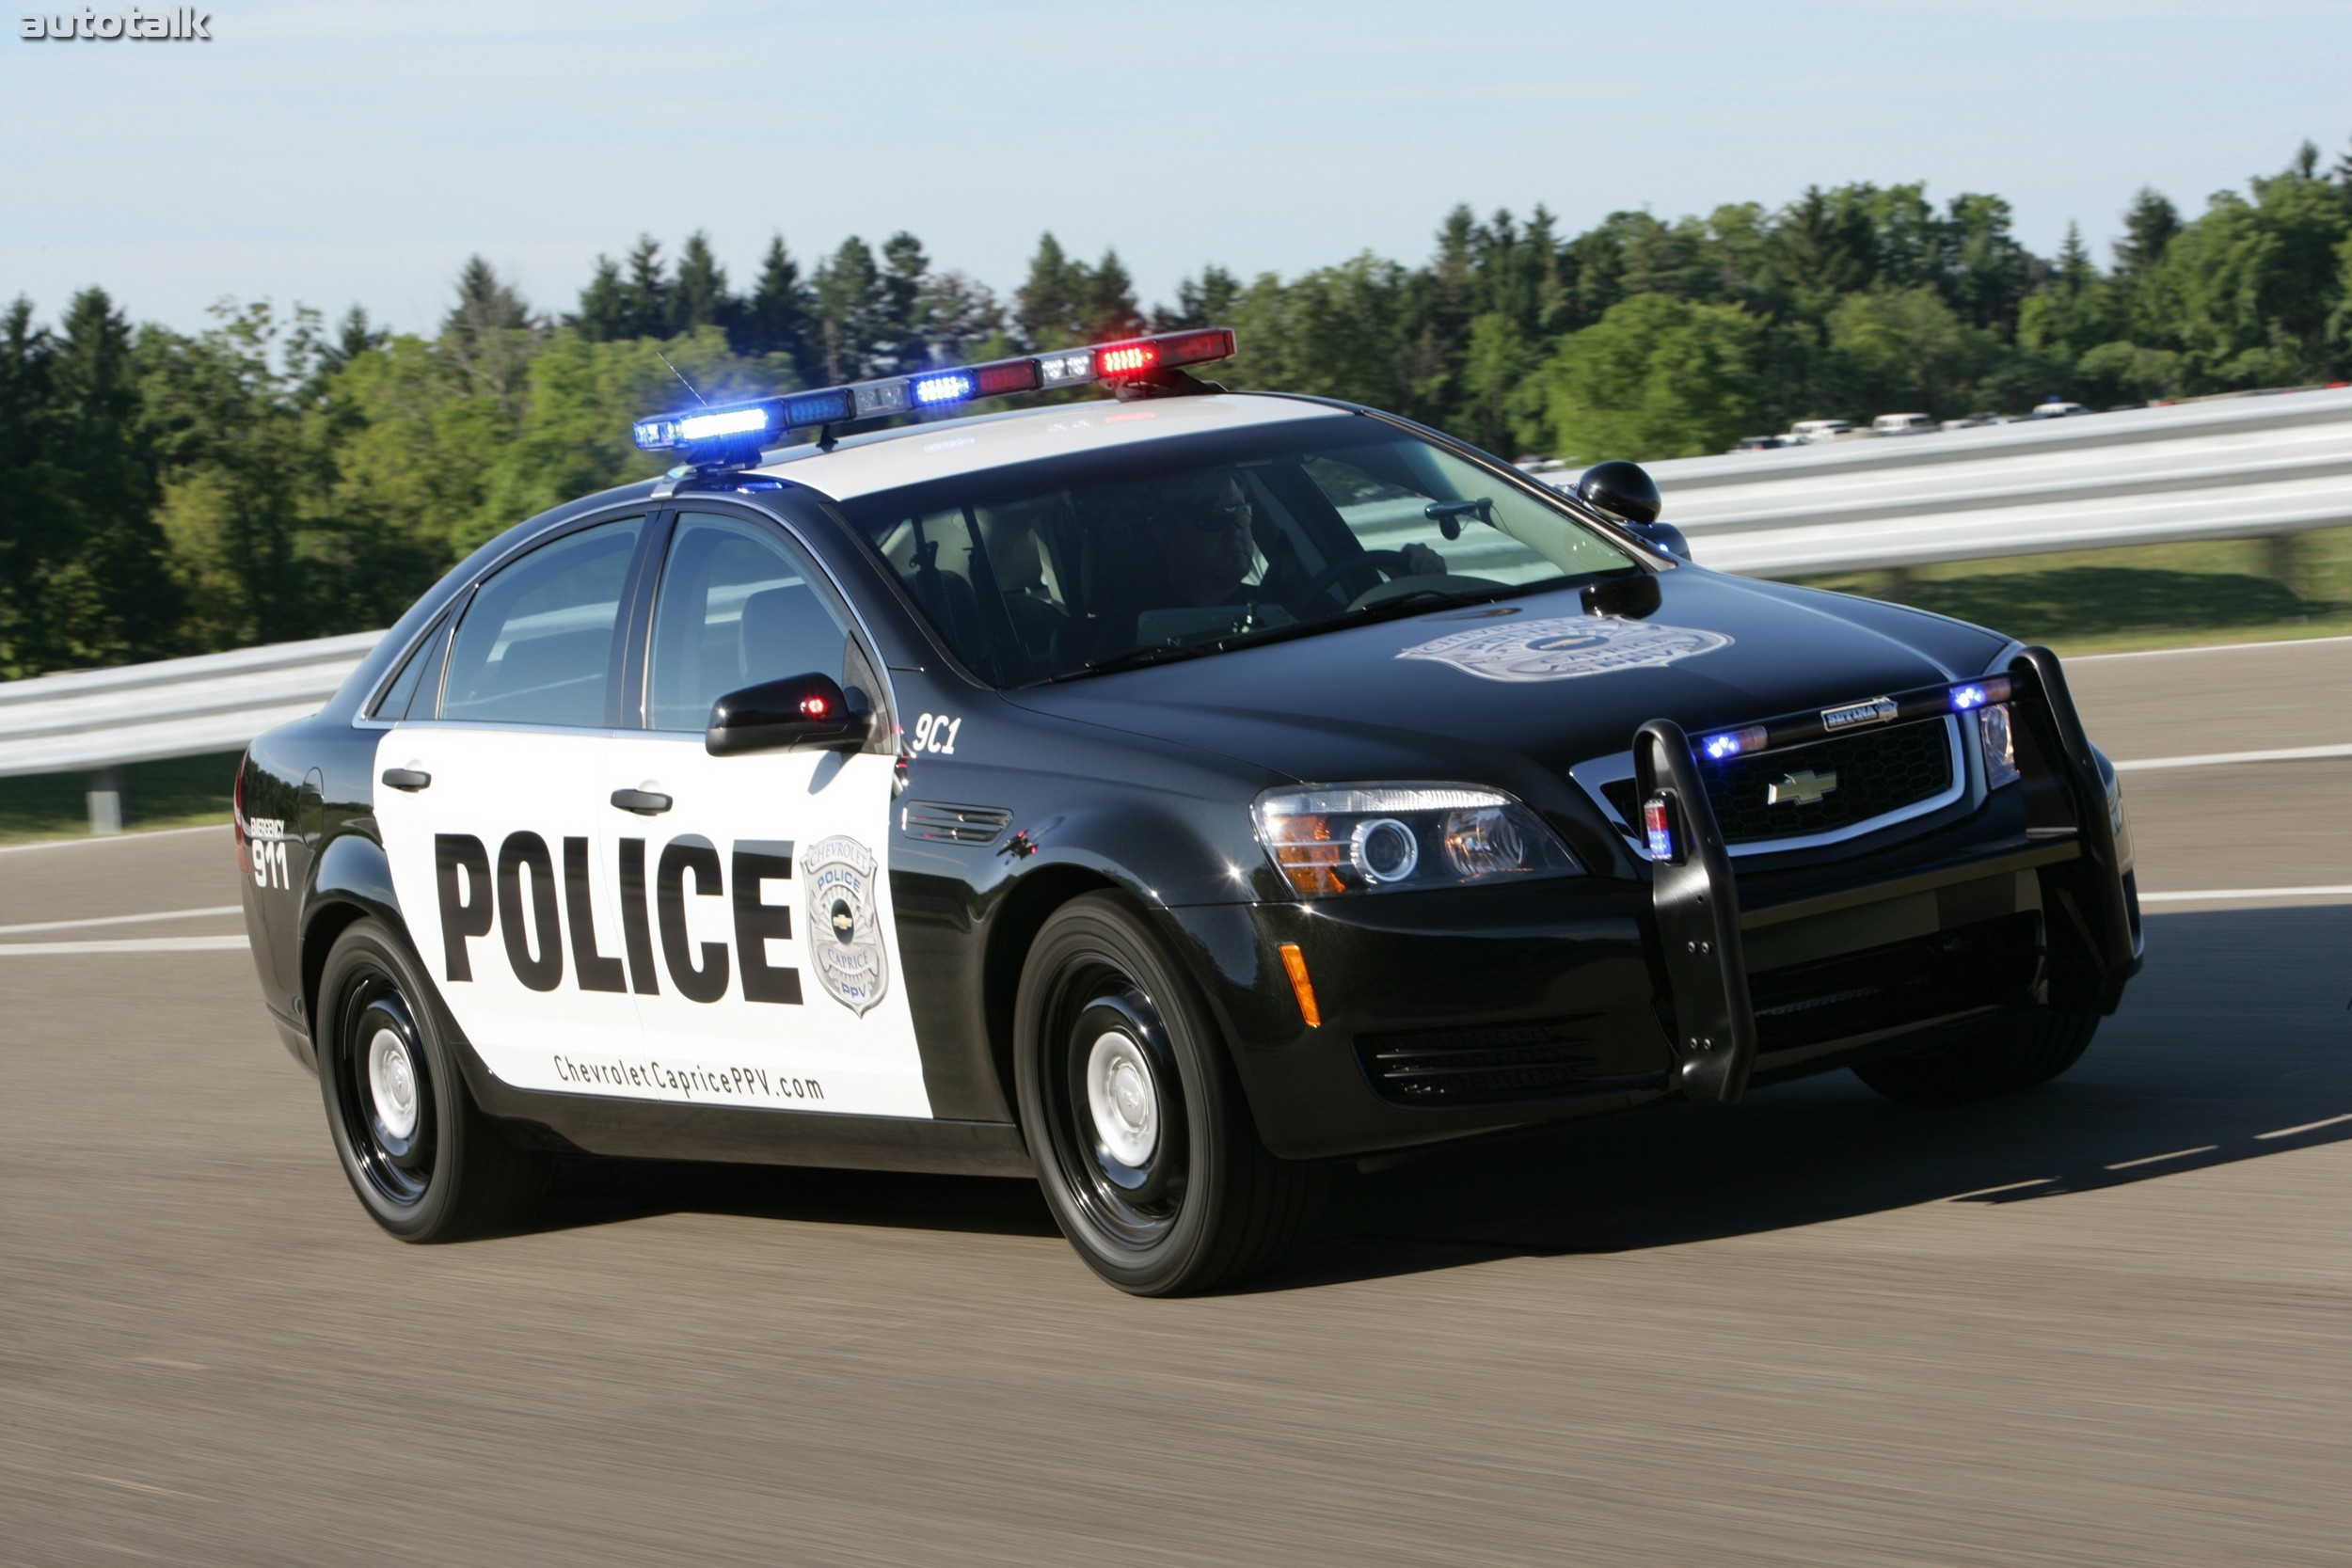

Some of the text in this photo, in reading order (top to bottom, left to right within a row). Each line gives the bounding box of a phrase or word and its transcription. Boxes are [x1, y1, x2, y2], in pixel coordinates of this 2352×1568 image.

[913, 713, 961, 754] 9C1
[252, 839, 290, 890] 911
[809, 843, 867, 870] CHEVROLET
[817, 868, 861, 894] POLICE
[434, 830, 803, 1006] POLICE
[827, 948, 868, 971] CAPRICE
[841, 983, 866, 998] PPV
[553, 1054, 825, 1100] ChevroletCapricePPV.com
